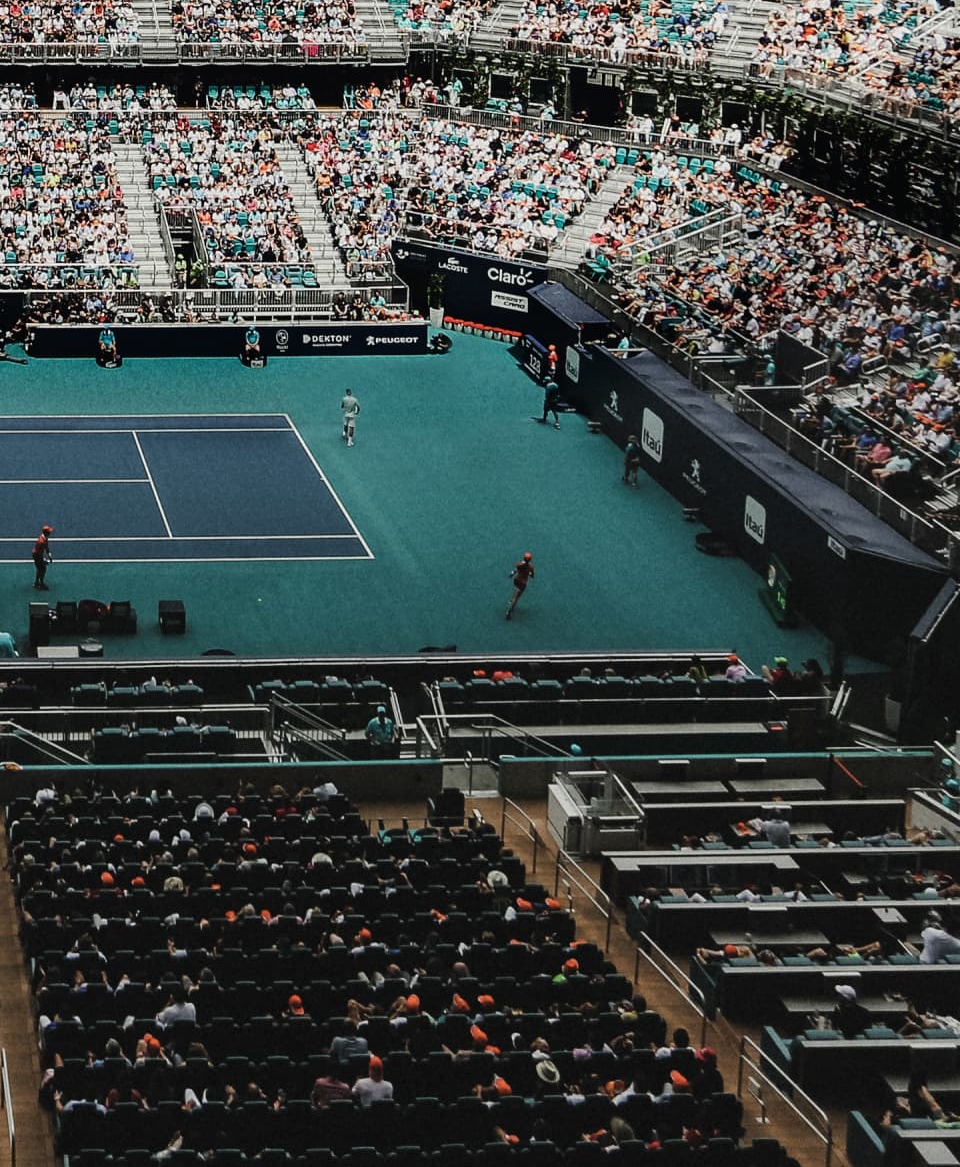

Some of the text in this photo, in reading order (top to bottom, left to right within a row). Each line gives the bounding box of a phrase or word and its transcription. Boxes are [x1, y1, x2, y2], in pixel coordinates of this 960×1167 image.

[438, 262, 469, 274] LACOSTE
[488, 268, 527, 286] Claro
[312, 335, 349, 343] DEKTON
[376, 336, 419, 345] PEUGEOT
[643, 428, 661, 455] Itaú
